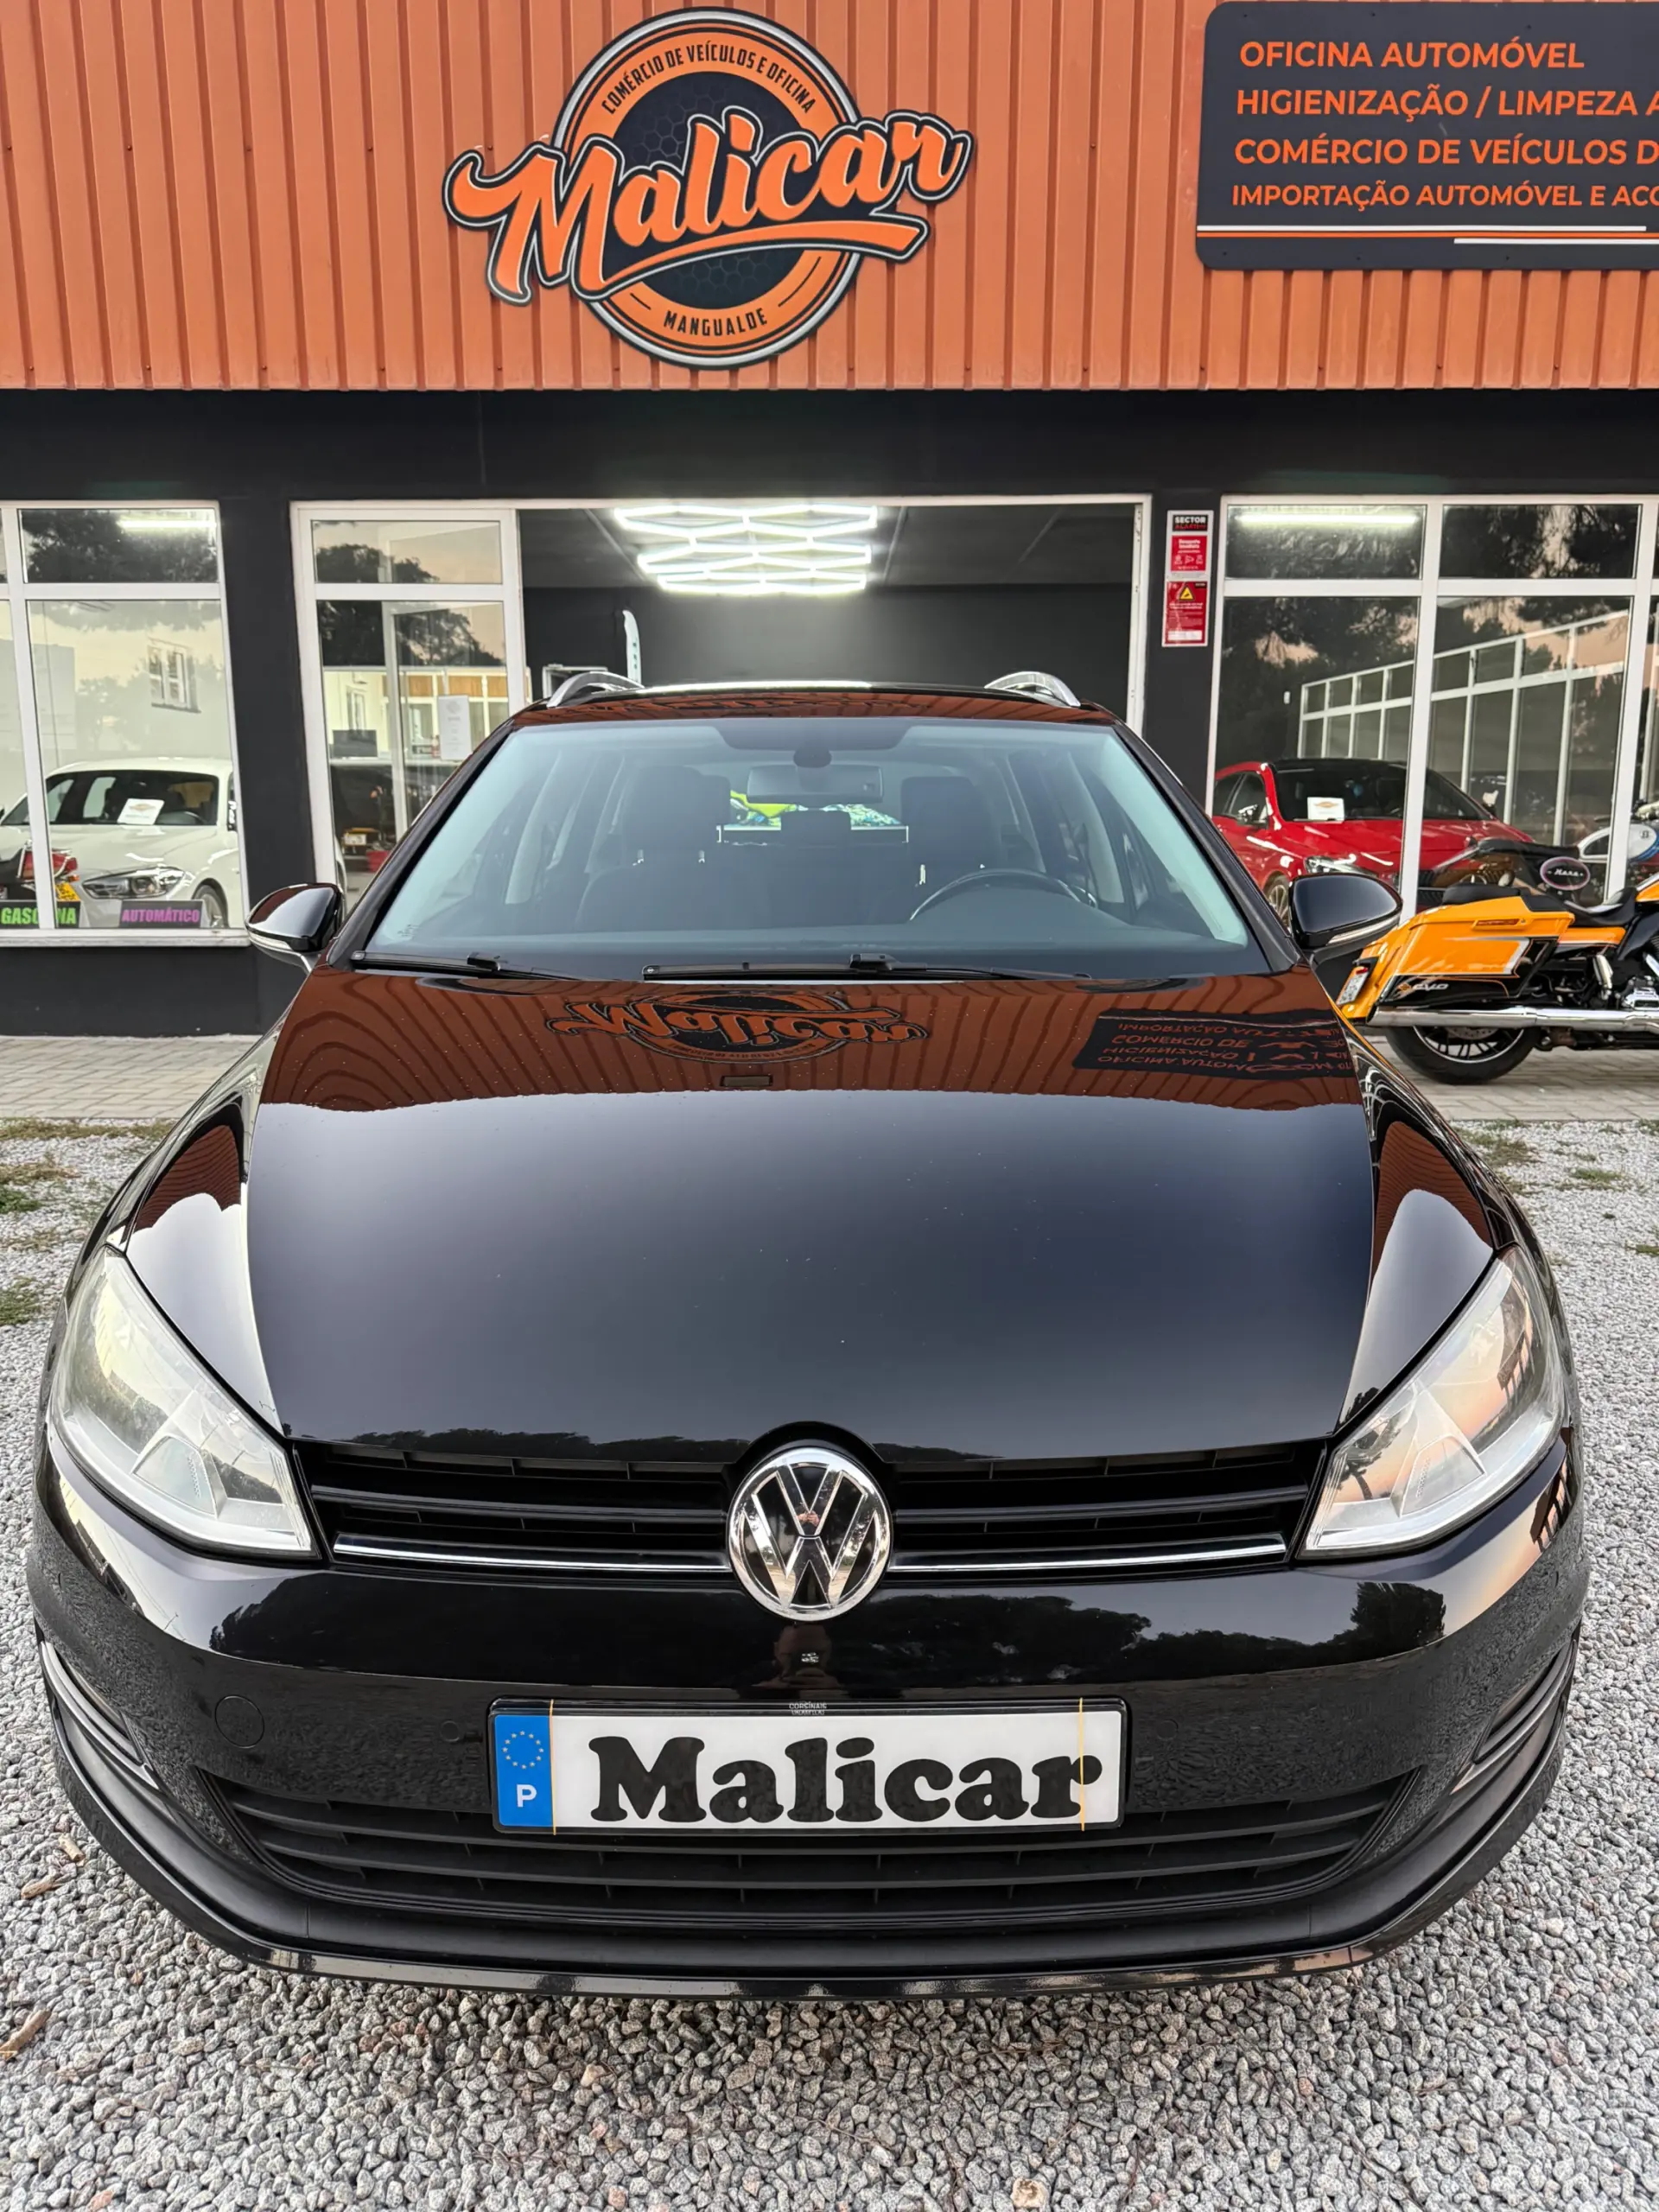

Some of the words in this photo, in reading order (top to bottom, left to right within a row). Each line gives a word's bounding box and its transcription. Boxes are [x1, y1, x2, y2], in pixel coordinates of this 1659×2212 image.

[1240, 41, 1373, 68] OFICINA
[1381, 36, 1585, 68] AUTOMÓVEL
[601, 54, 664, 114] COMÉRCIO
[664, 48, 683, 68] DE
[686, 41, 757, 69] VEÍCULOS
[756, 56, 767, 73] E
[766, 62, 816, 113] OFICINA
[1236, 84, 1468, 123] HIGIENIZAÇÃO
[1497, 90, 1638, 117] LIMPEZA
[1234, 133, 1408, 165] COMÉRCIO
[1417, 139, 1460, 165] DE
[1470, 133, 1627, 165] VEÍCULOS
[446, 111, 968, 299] Malicar
[1232, 180, 1409, 212] IMPORTAÇÃO
[1416, 181, 1582, 207] AUTOMÓVEL
[1590, 186, 1605, 207] E
[663, 308, 767, 336] MANGUALDE
[122, 906, 200, 923] AUTOMÁTICO
[517, 1784, 537, 1808] P
[588, 1736, 1103, 1824] Malicar
